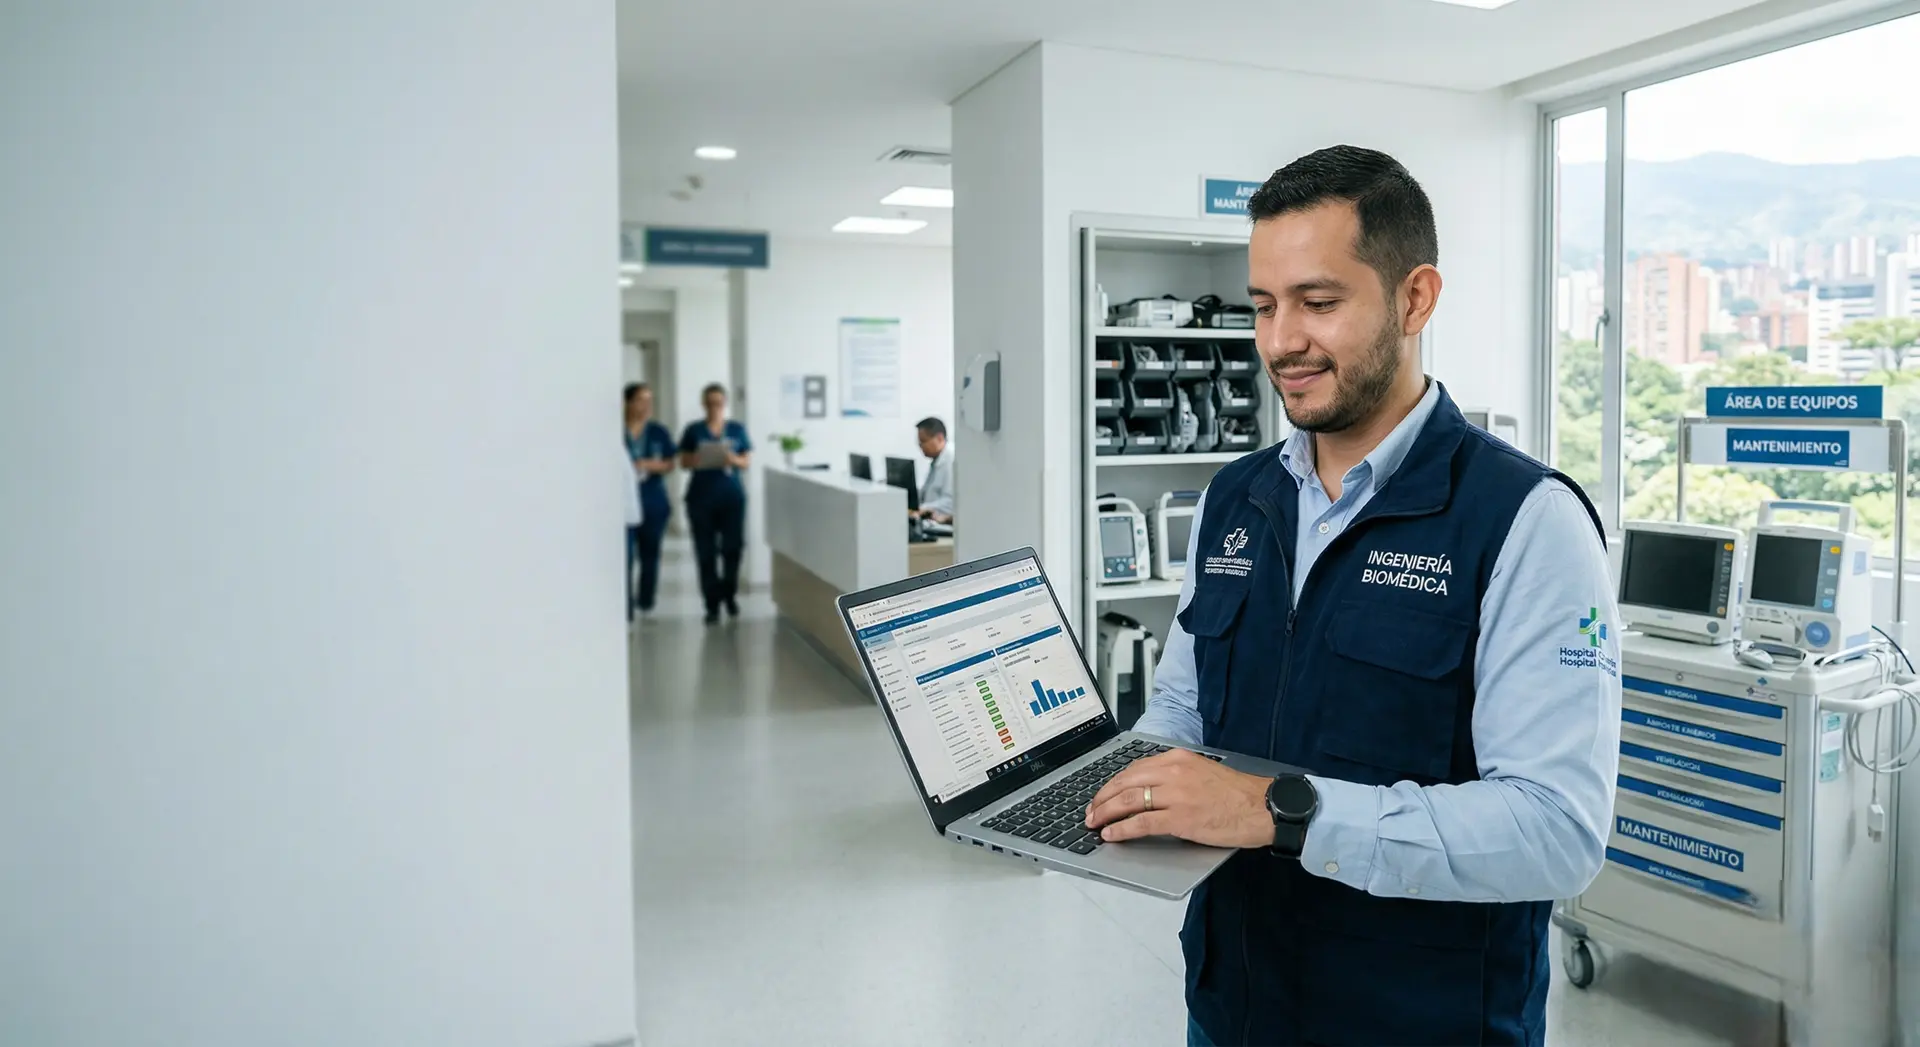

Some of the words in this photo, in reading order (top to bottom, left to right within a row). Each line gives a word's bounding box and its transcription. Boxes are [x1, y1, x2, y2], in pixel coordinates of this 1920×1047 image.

[1724, 392, 1763, 409] ÁREA
[1766, 395, 1786, 409] DE
[1790, 395, 1858, 412] EQUIPOS
[1733, 439, 1841, 455] MANTENIMIENTO
[1367, 550, 1452, 575] INGENIERÍA
[1361, 568, 1448, 596] BIOMÉDICA
[1559, 647, 1597, 659] Hospital
[1559, 657, 1597, 668] Hospital
[1620, 820, 1740, 867] MANTENIMIENTO
